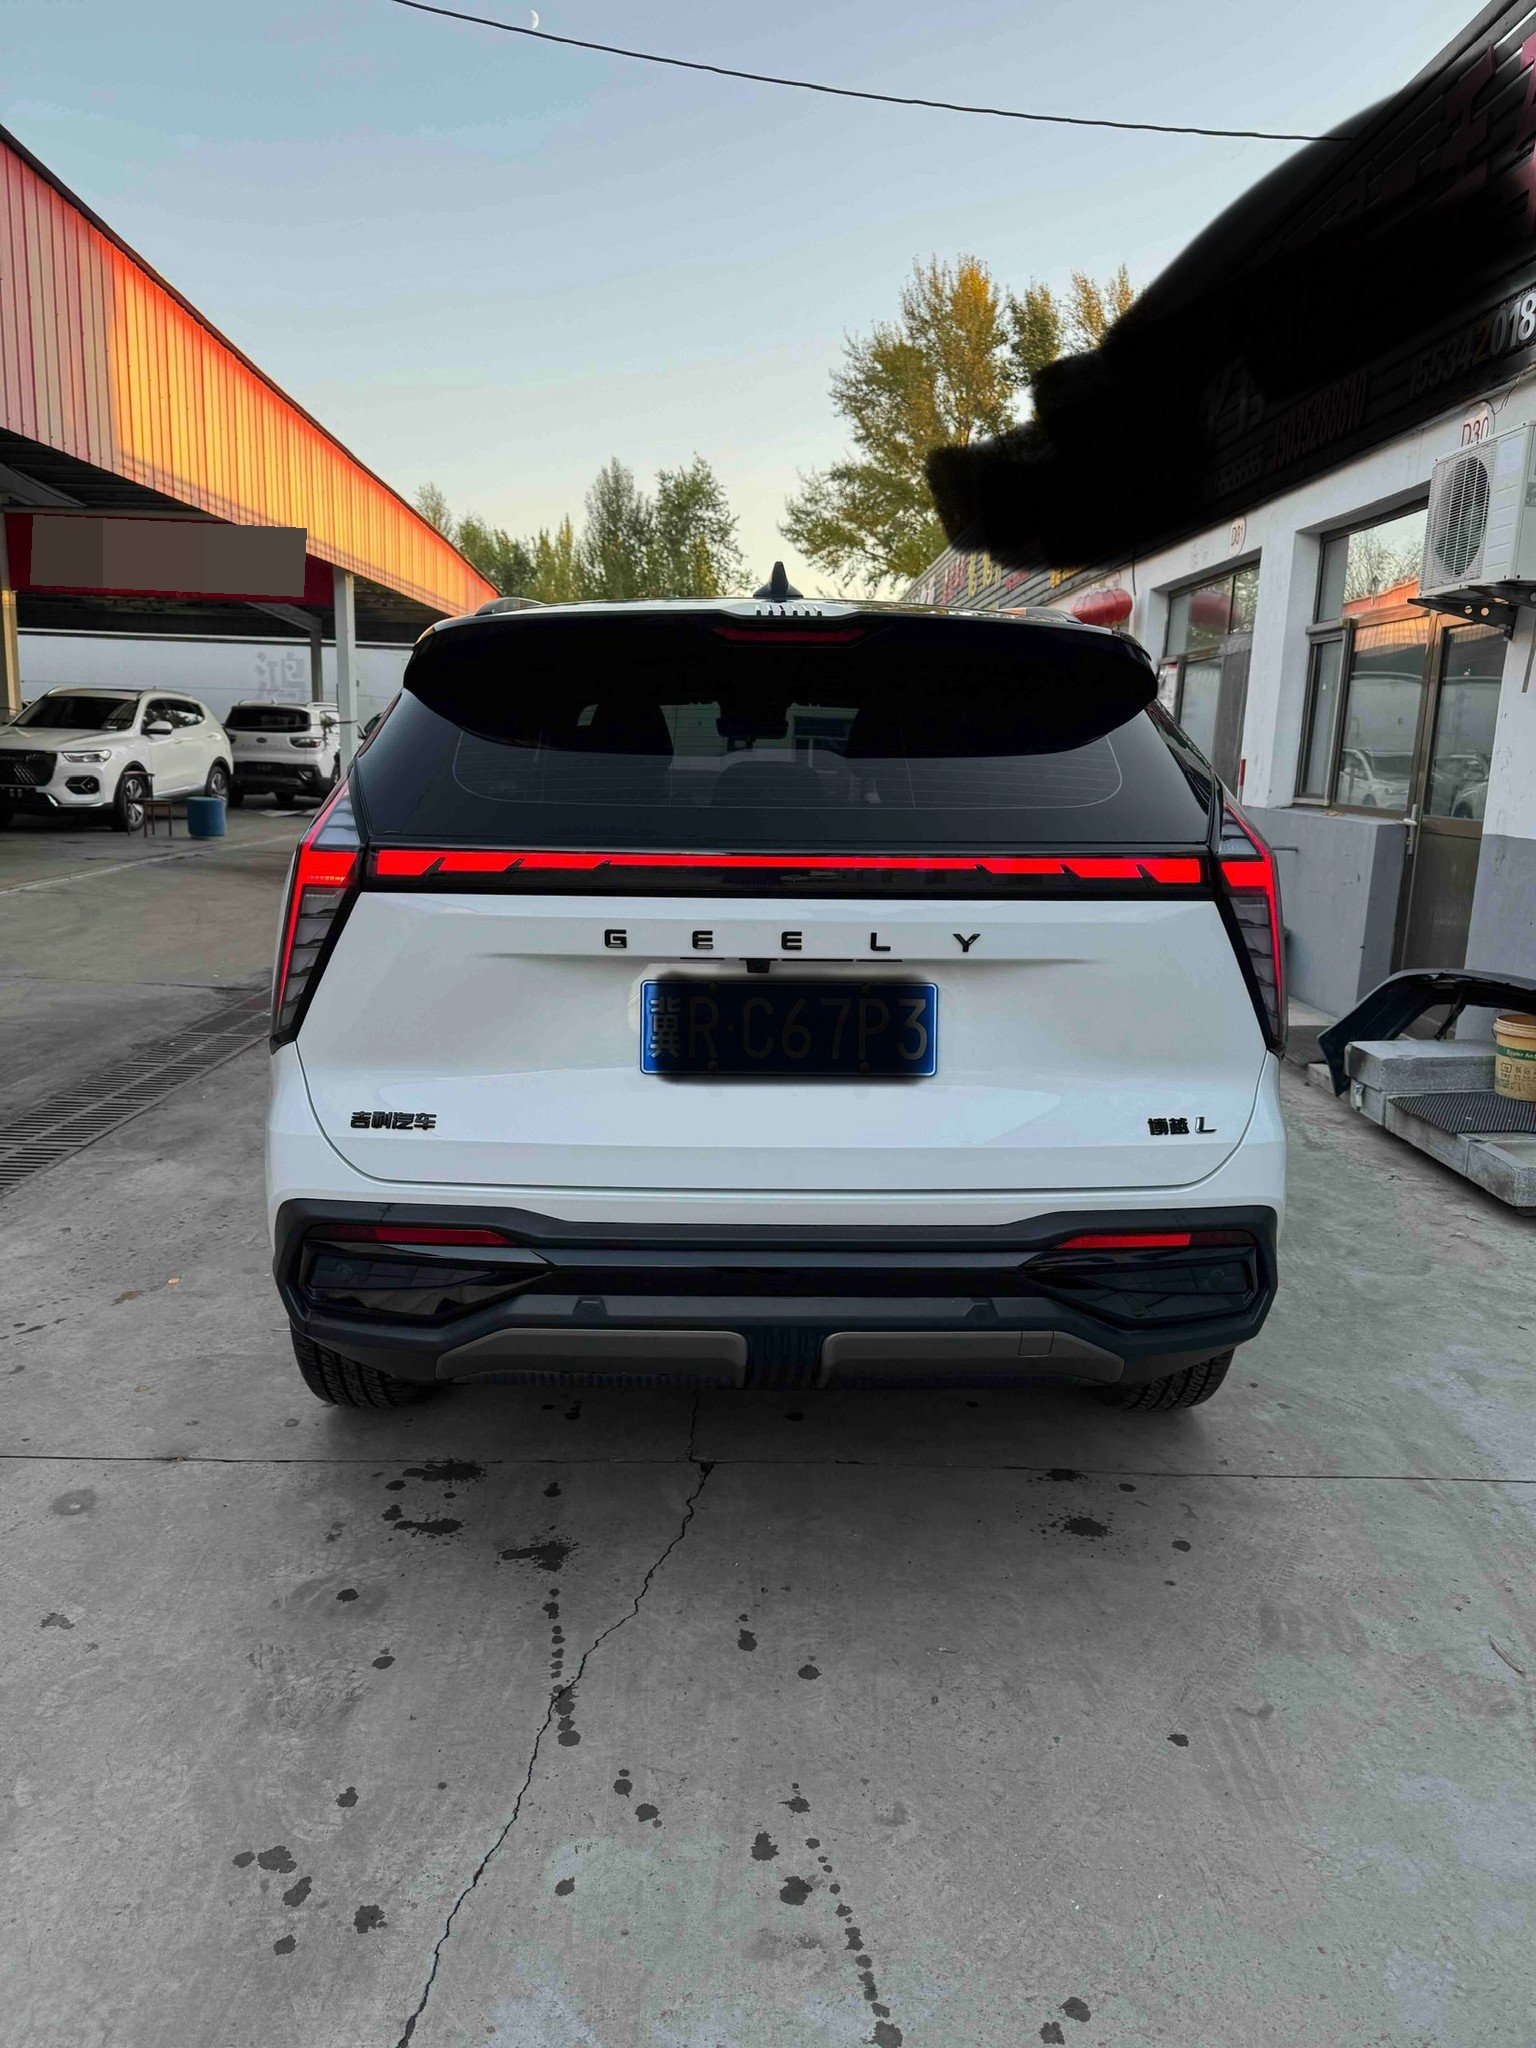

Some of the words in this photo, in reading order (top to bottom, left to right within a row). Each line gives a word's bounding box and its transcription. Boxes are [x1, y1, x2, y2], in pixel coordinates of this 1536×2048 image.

[604, 928, 981, 953] GEELY
[350, 1110, 437, 1131] 吉利汽车
